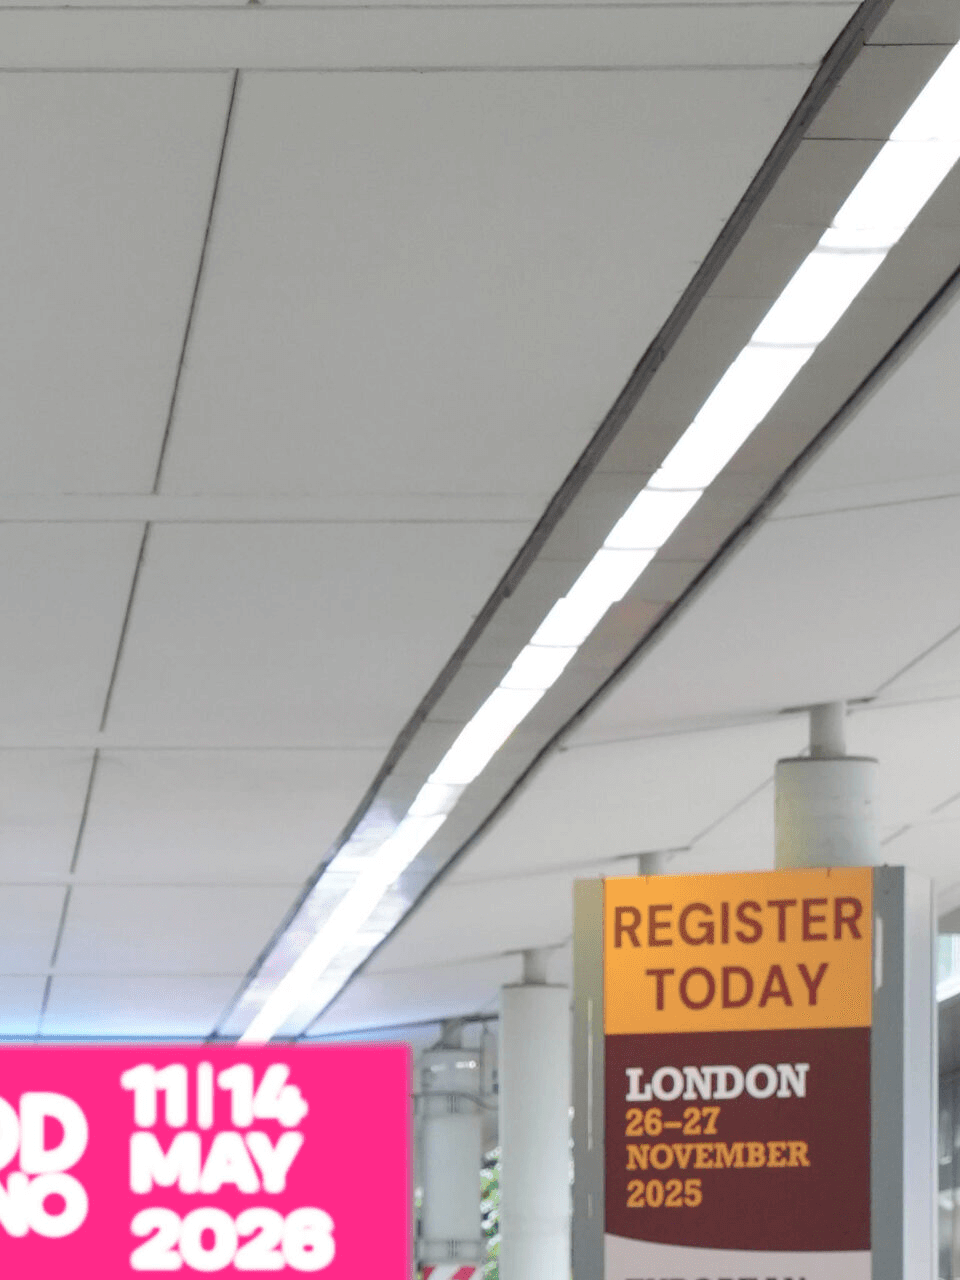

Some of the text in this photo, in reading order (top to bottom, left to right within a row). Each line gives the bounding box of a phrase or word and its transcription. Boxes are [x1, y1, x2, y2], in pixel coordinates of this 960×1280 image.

[613, 896, 864, 949] REGISTER
[644, 962, 830, 1011] TODAY
[625, 1063, 810, 1101] LONDON
[130, 1131, 304, 1194] MAY
[625, 1140, 811, 1170] NOVEMBER
[626, 1178, 703, 1208] 2025
[130, 1206, 336, 1272] 2026
